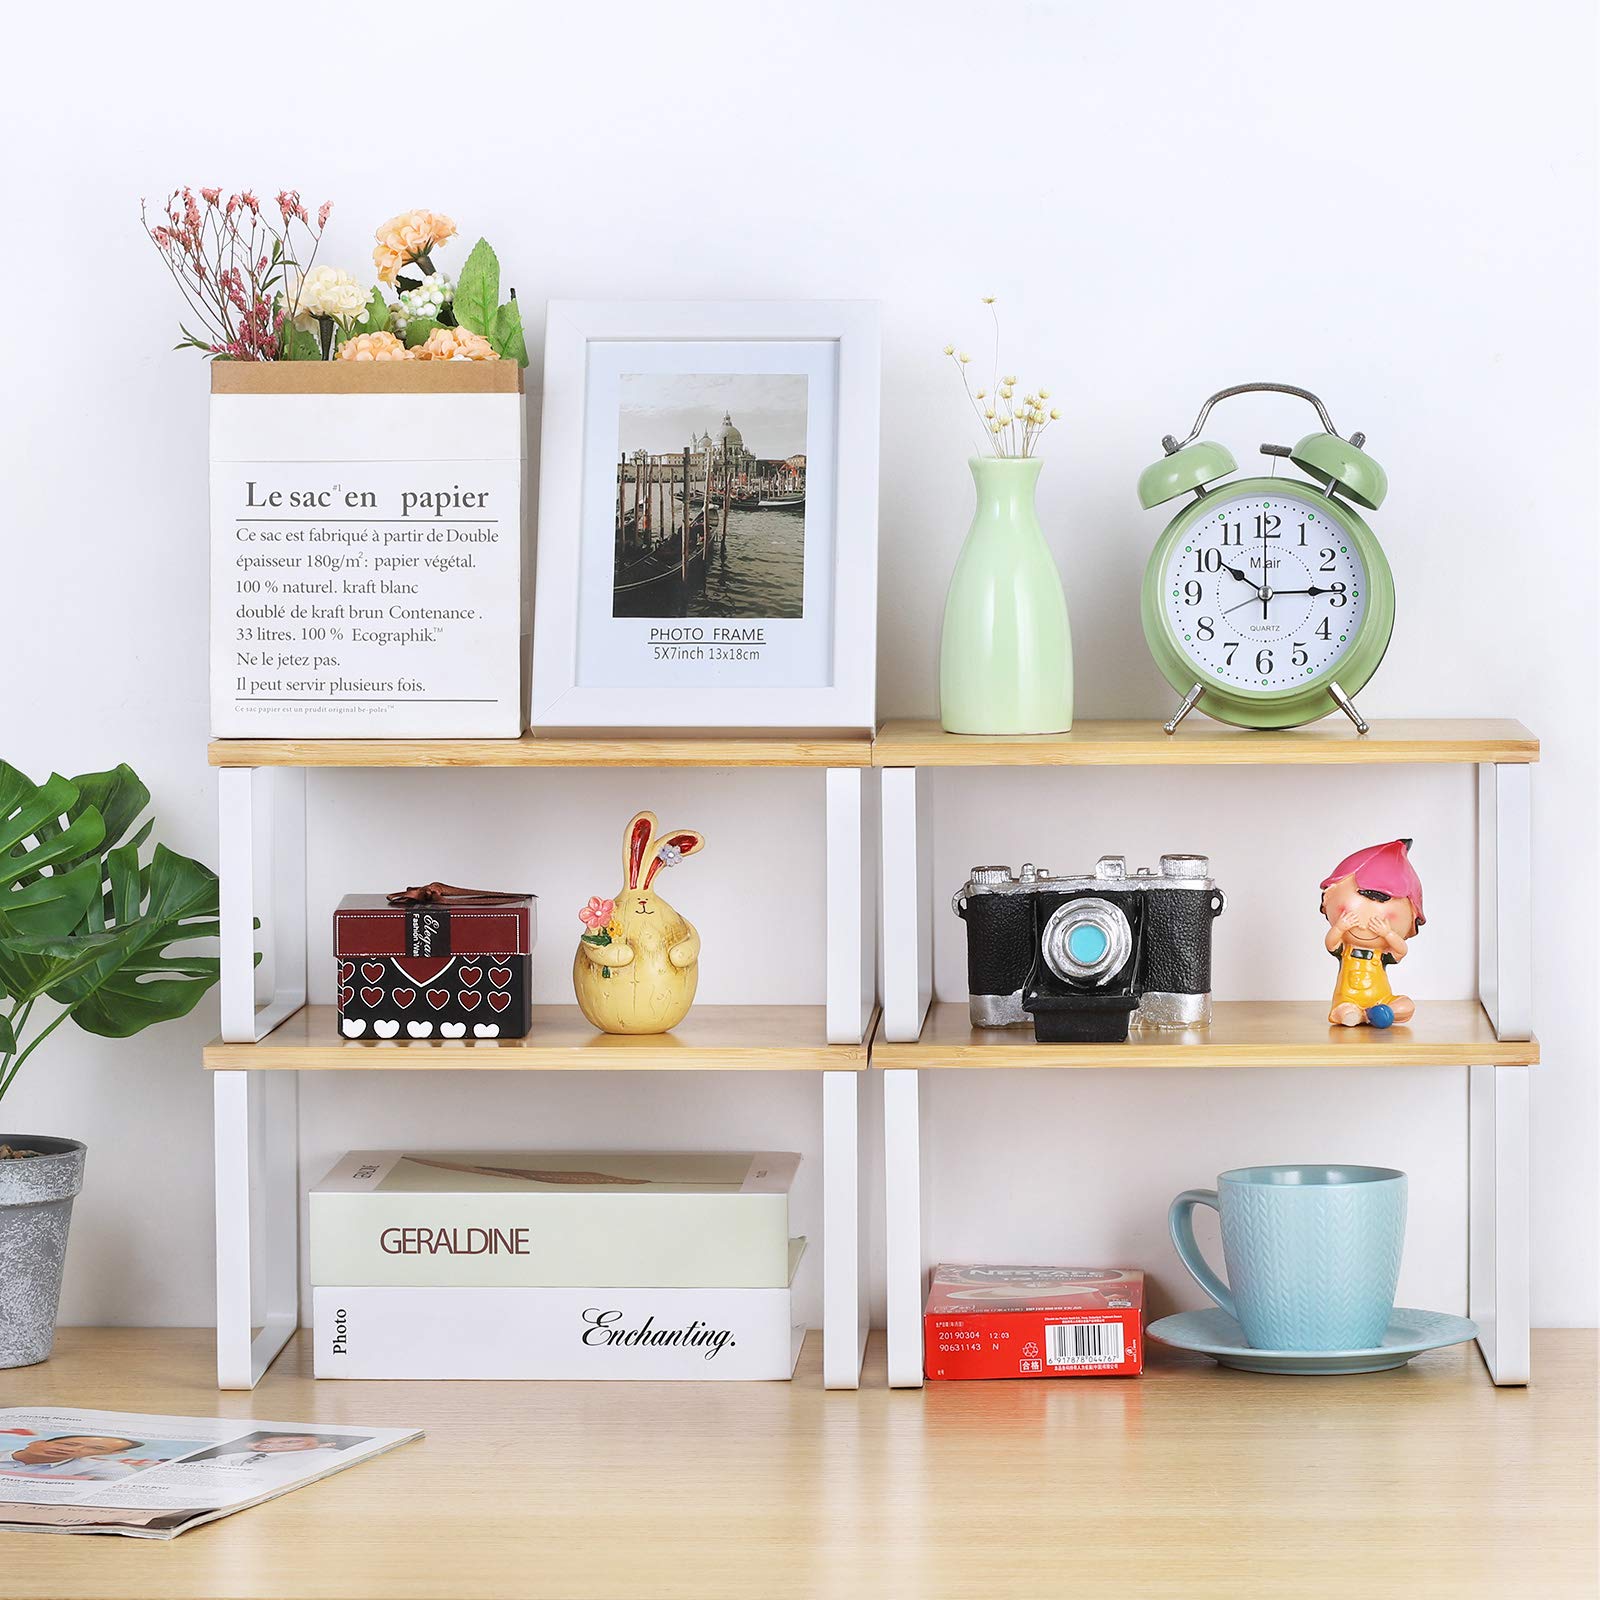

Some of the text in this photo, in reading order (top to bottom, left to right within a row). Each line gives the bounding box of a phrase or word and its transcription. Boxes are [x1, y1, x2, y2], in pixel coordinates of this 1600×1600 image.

[246, 482, 282, 507] Le
[290, 492, 331, 507] sac
[345, 492, 377, 507] en
[401, 485, 489, 516] papier
[236, 528, 498, 546] Ce sac est fabriqué à partir de Double
[1221, 523, 1243, 546] 11
[1253, 515, 1281, 538] 12
[1298, 523, 1308, 546] 1
[236, 555, 302, 571] épaisseur
[375, 554, 420, 571] papier
[424, 554, 475, 572] végétal.
[1194, 548, 1222, 574] 10
[1320, 548, 1336, 571] 2
[237, 580, 418, 594] 100 % naturel. kraft blanc
[1185, 580, 1202, 606] 9
[1330, 582, 1347, 607] 3
[236, 605, 285, 618] doublé
[291, 605, 307, 618] de
[312, 605, 344, 618] kraft
[349, 605, 383, 618] brun
[237, 628, 252, 640] 33
[257, 627, 295, 641] litres.
[303, 628, 325, 640] 100
[330, 628, 343, 640] %
[651, 628, 763, 640] PHOTO FRAME
[1197, 617, 1214, 641] 8
[1315, 617, 1332, 640] 4
[237, 652, 340, 670] Ne le jetez pas.
[654, 646, 759, 660] 5X7inch 13x18cm
[1223, 643, 1239, 665] 7
[1256, 649, 1273, 674] 6
[1292, 642, 1308, 666] 5
[237, 677, 425, 695] Il peut servir plusieurs fois.
[258, 706, 280, 714] papier
[328, 705, 356, 714] original
[380, 1228, 530, 1254] GERALDINE
[333, 1309, 346, 1354] Photo
[582, 1308, 735, 1360] Enchanting.
[939, 1331, 980, 1340] 20190304
[939, 1343, 981, 1351] 90631143
[1022, 1361, 1039, 1370] 合格
